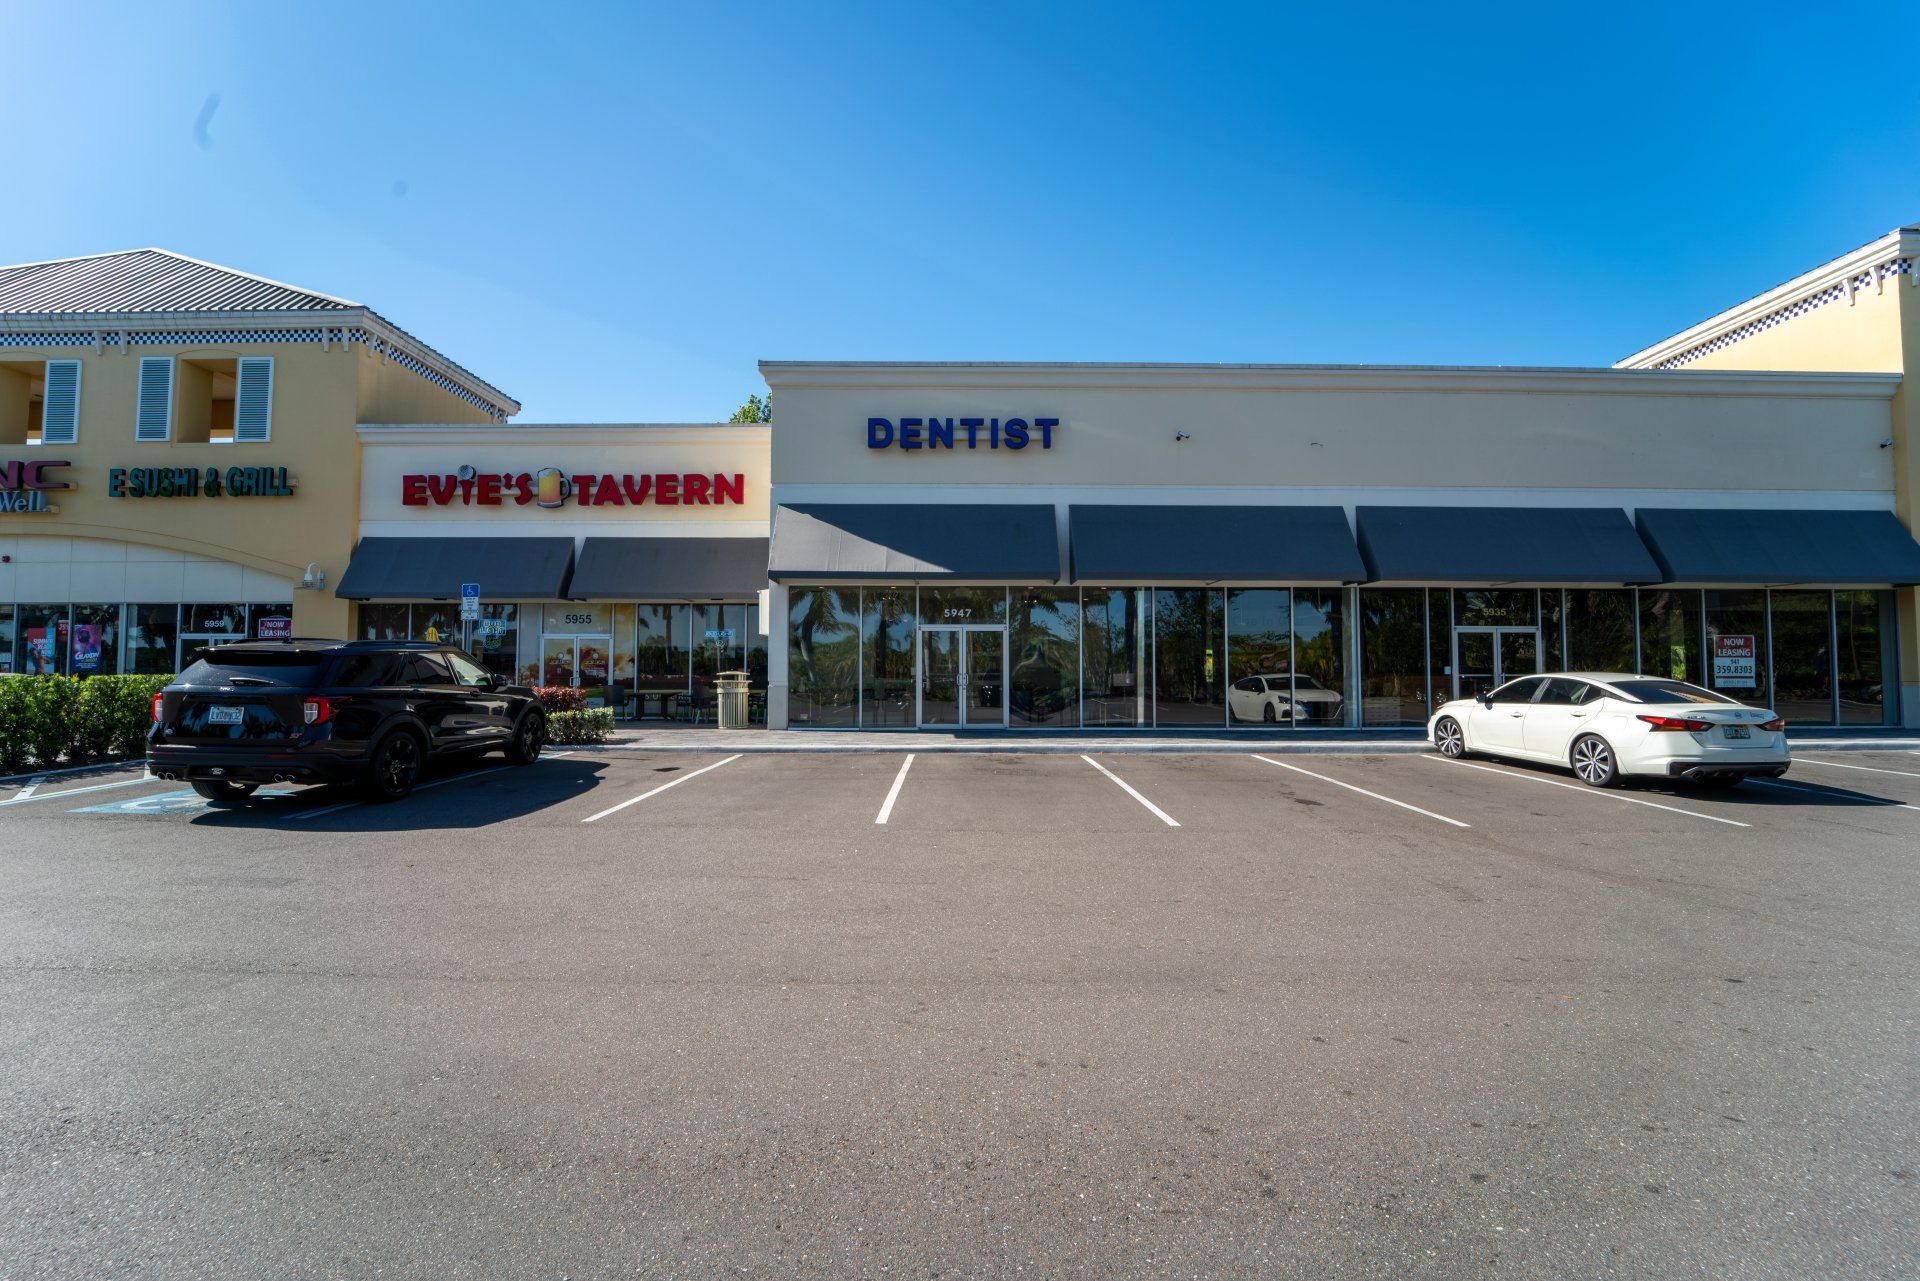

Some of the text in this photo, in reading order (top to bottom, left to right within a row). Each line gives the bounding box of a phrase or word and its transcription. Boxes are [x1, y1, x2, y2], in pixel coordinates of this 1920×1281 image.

[868, 418, 1059, 449] DENTIST
[109, 466, 294, 498] E SUSHI & GRILL
[402, 465, 745, 506] EVIE'S TAVERN
[943, 608, 972, 618] 5947
[1483, 607, 1507, 616] 5935
[565, 614, 592, 624] 5955
[204, 620, 225, 628] 5959
[260, 629, 291, 637] LEASING
[1723, 638, 1744, 646] NOW
[1718, 648, 1751, 656] LEASING
[1716, 665, 1753, 674] 359.8303
